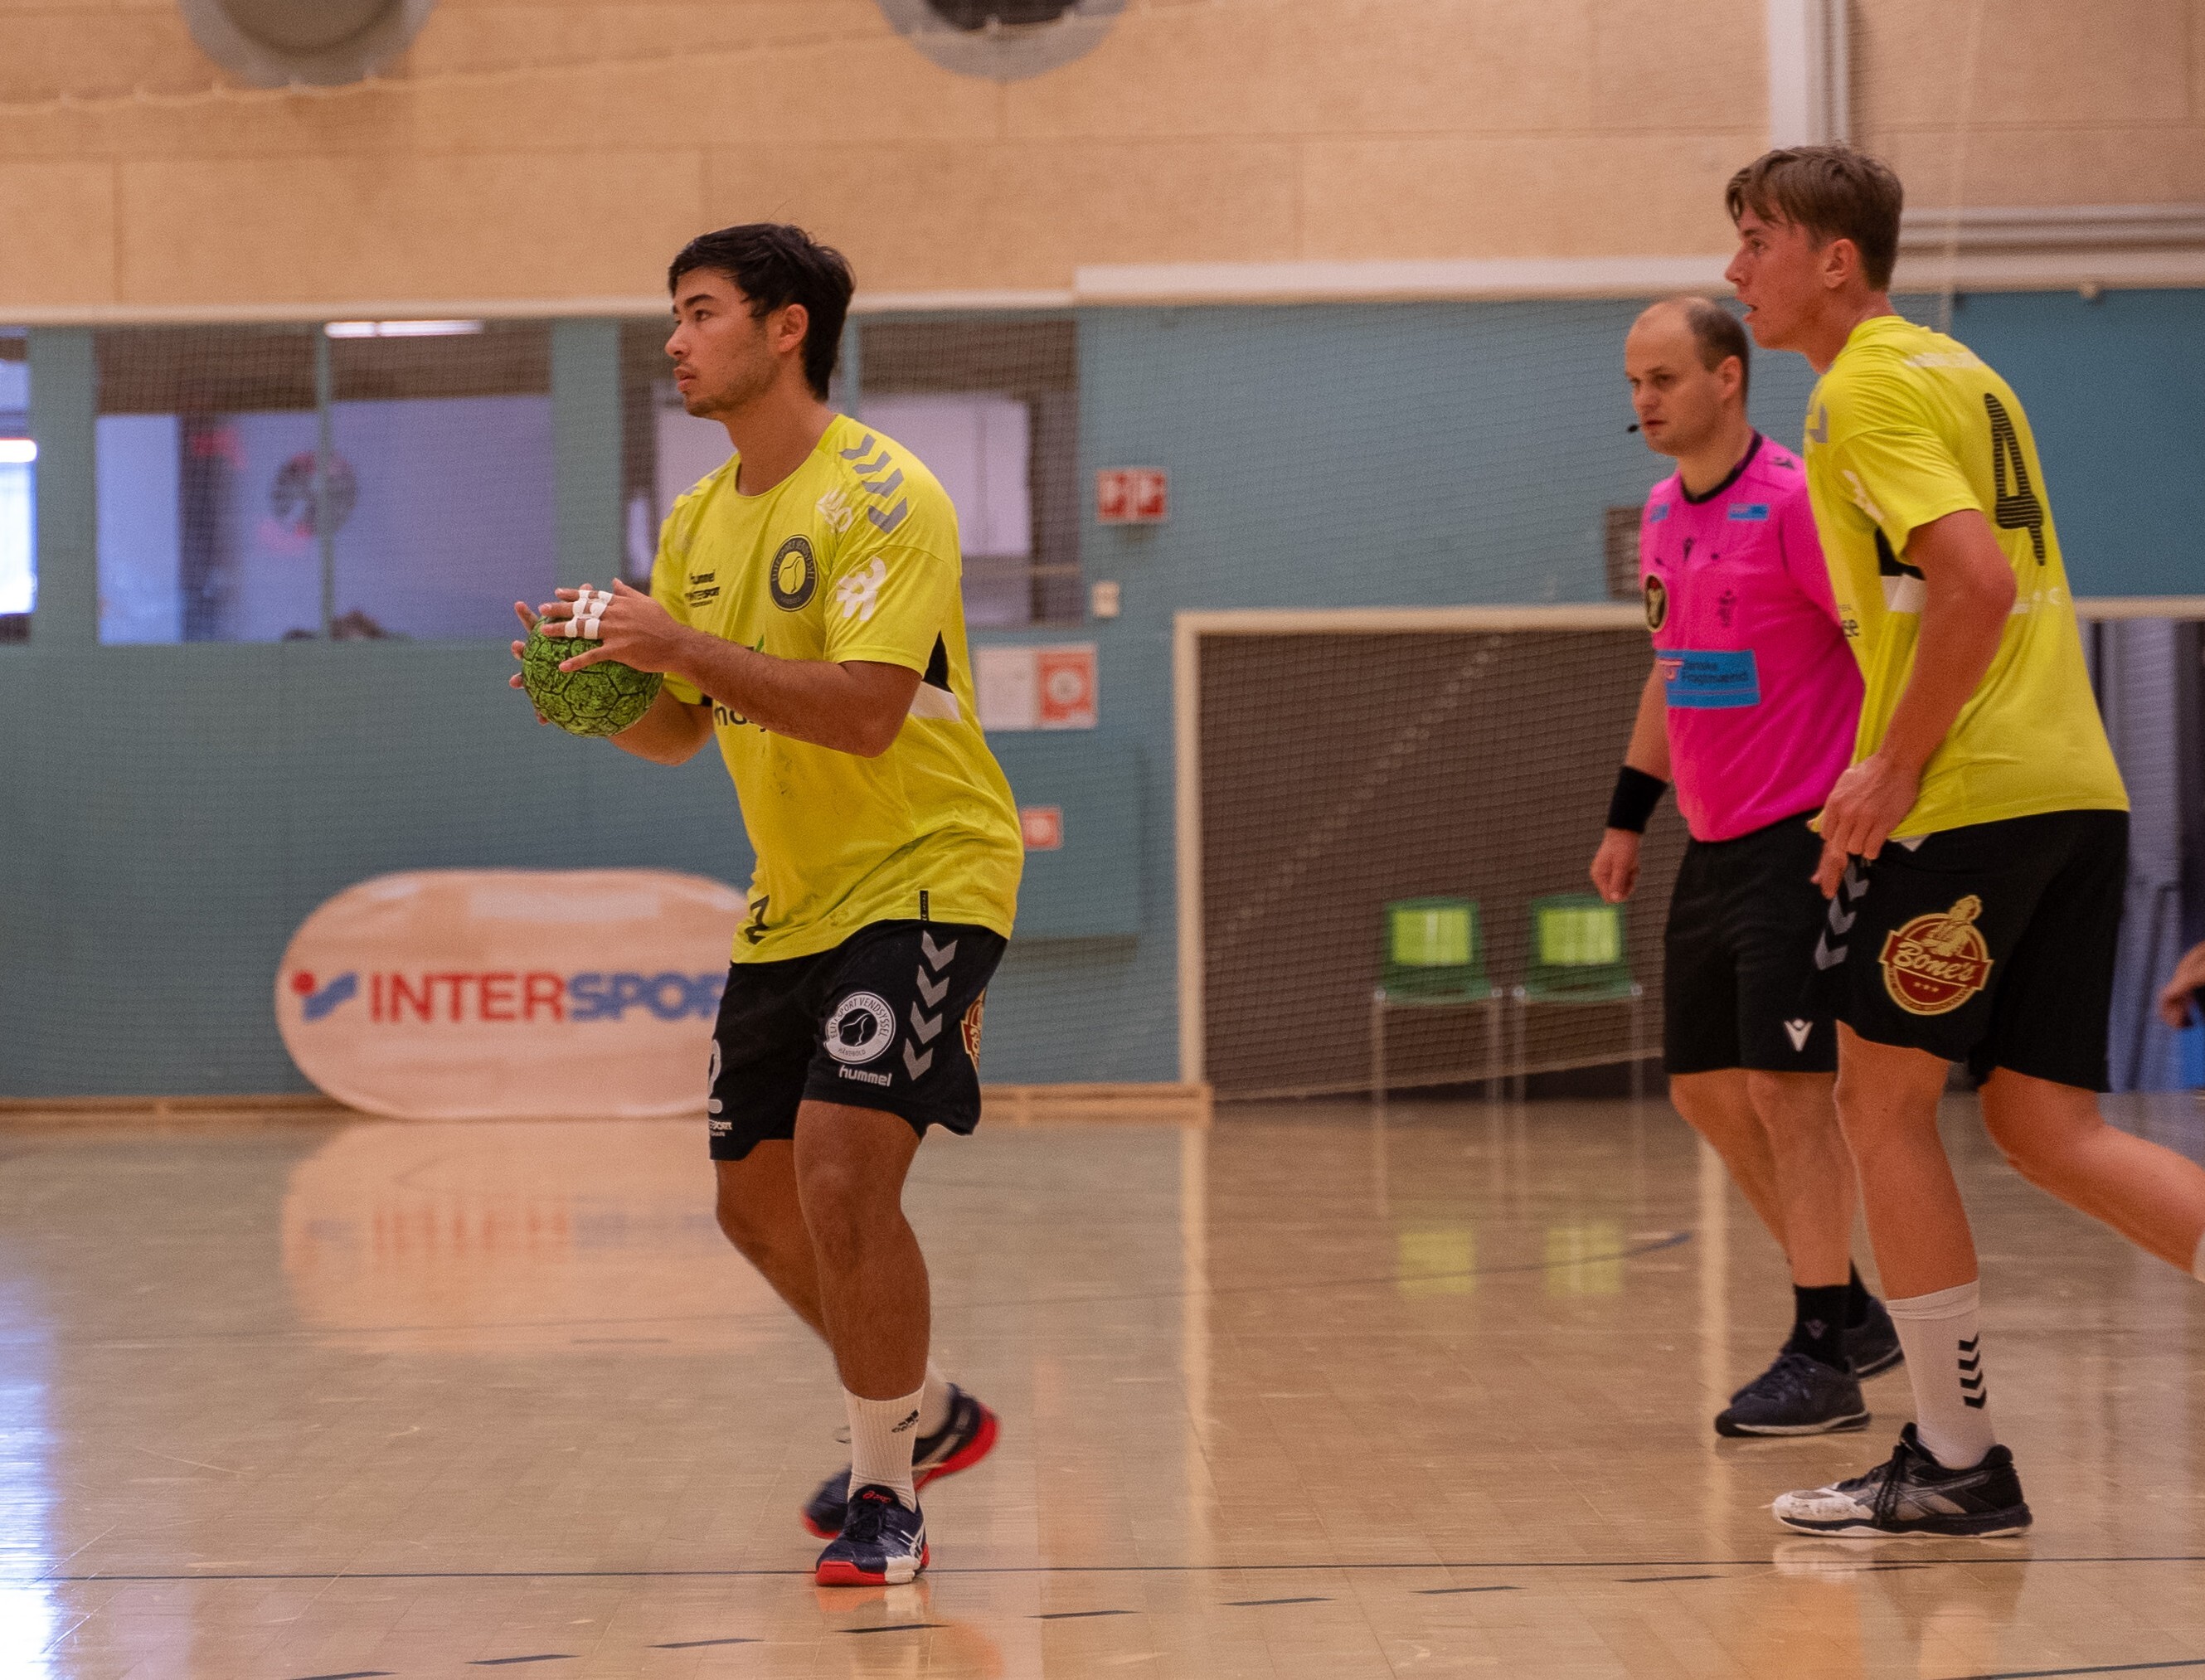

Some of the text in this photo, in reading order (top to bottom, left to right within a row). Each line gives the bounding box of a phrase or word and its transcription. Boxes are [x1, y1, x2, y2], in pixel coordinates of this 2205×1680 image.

[1984, 393, 2046, 566] 4
[370, 971, 727, 1022] INTERSPOR
[859, 997, 890, 1037] VENDSYSSEL
[838, 1065, 892, 1087] hummel
